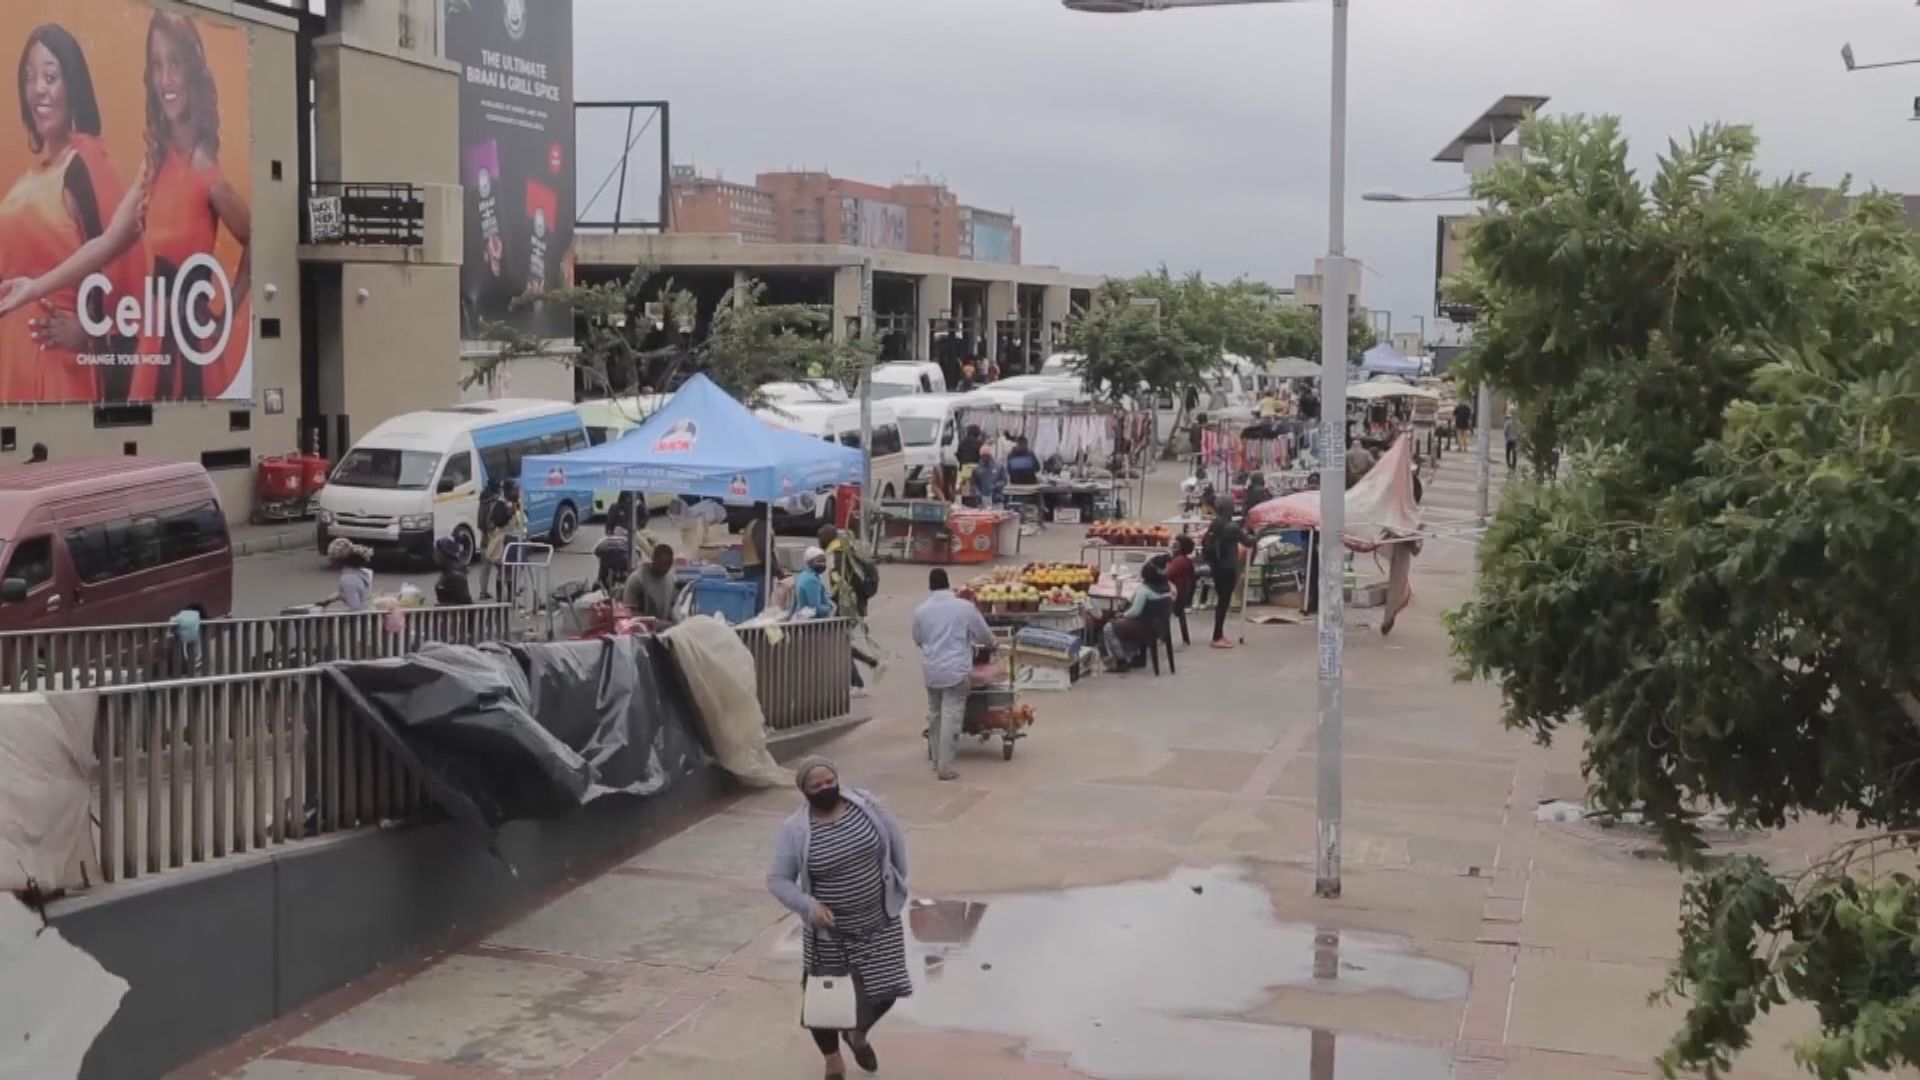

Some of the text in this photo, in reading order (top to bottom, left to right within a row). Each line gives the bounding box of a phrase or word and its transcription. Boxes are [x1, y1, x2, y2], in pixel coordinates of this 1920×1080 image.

[482, 49, 547, 79] THE ULTIMATE
[467, 65, 498, 87] BRAAI
[507, 75, 534, 95] GRILL
[534, 81, 560, 101] SPICE
[77, 273, 166, 337] Cell
[76, 353, 171, 366] CHANGE YOUR WORLD
